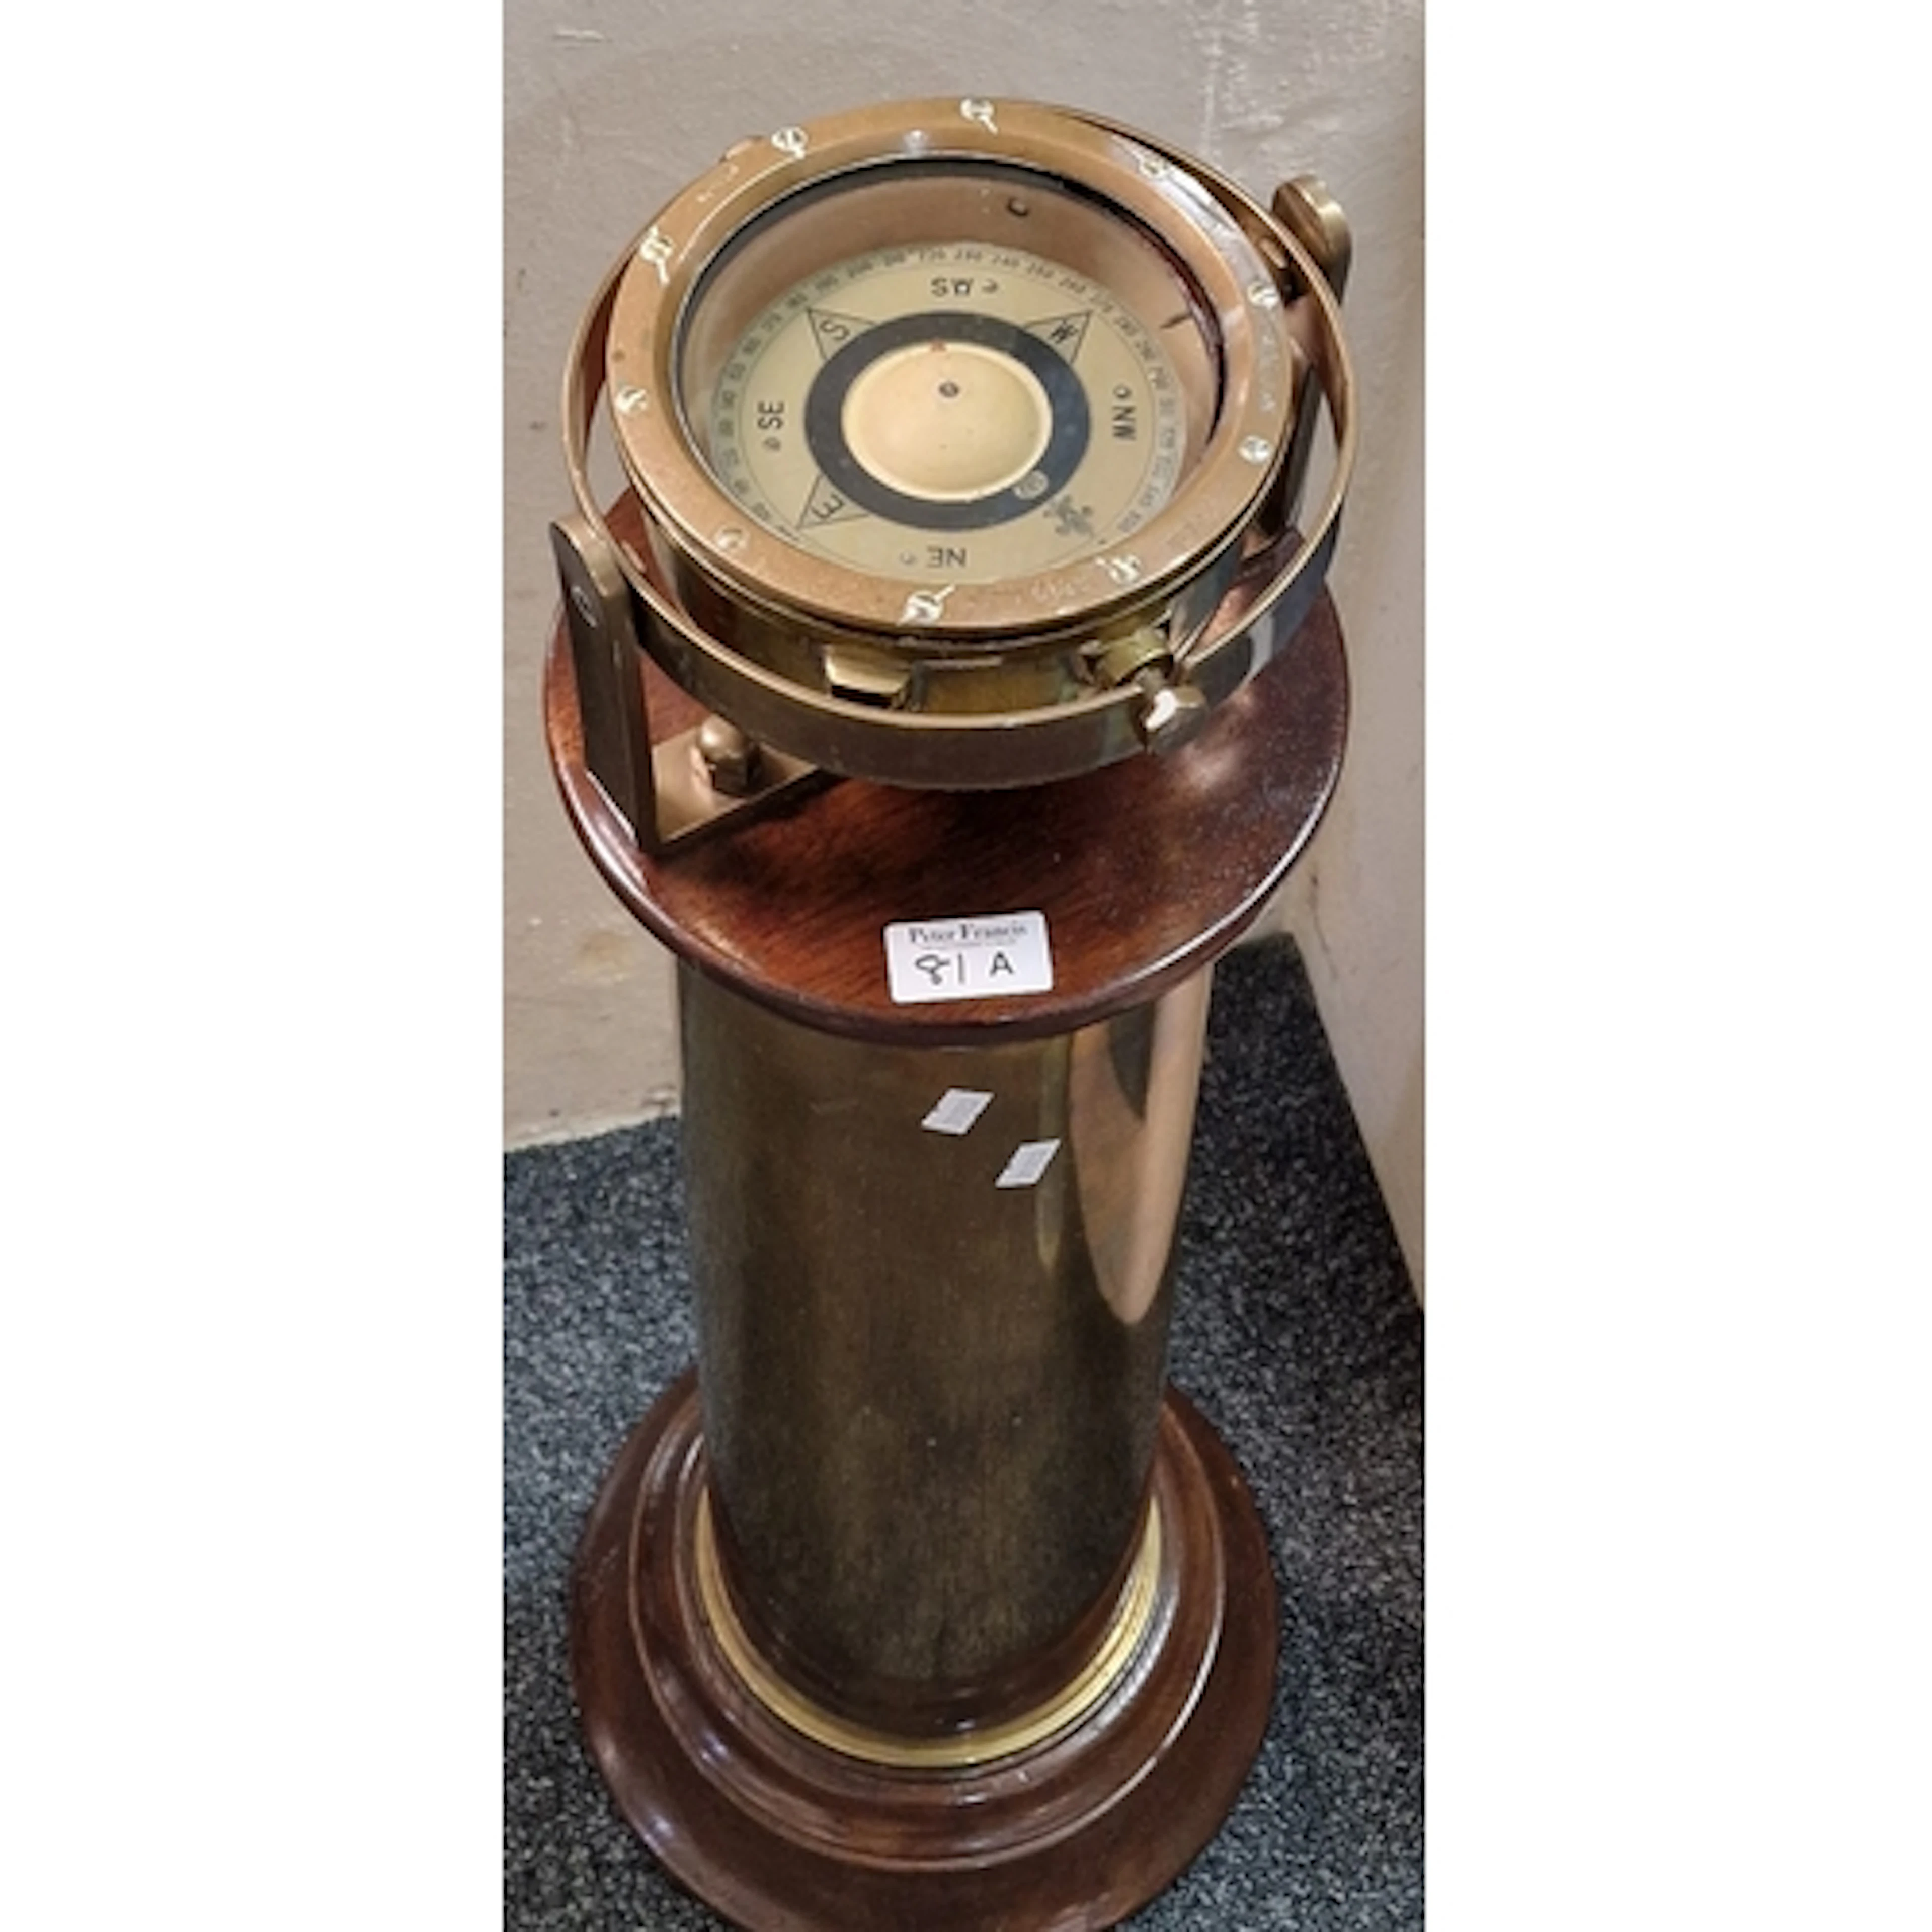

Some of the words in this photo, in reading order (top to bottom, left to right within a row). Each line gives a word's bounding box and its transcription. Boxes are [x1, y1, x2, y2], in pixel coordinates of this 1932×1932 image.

[819, 319, 850, 341] S
[757, 400, 784, 429] SE
[1112, 406, 1137, 441] NW
[811, 493, 845, 519] E
[927, 545, 967, 569] NE
[990, 951, 1014, 976] A
